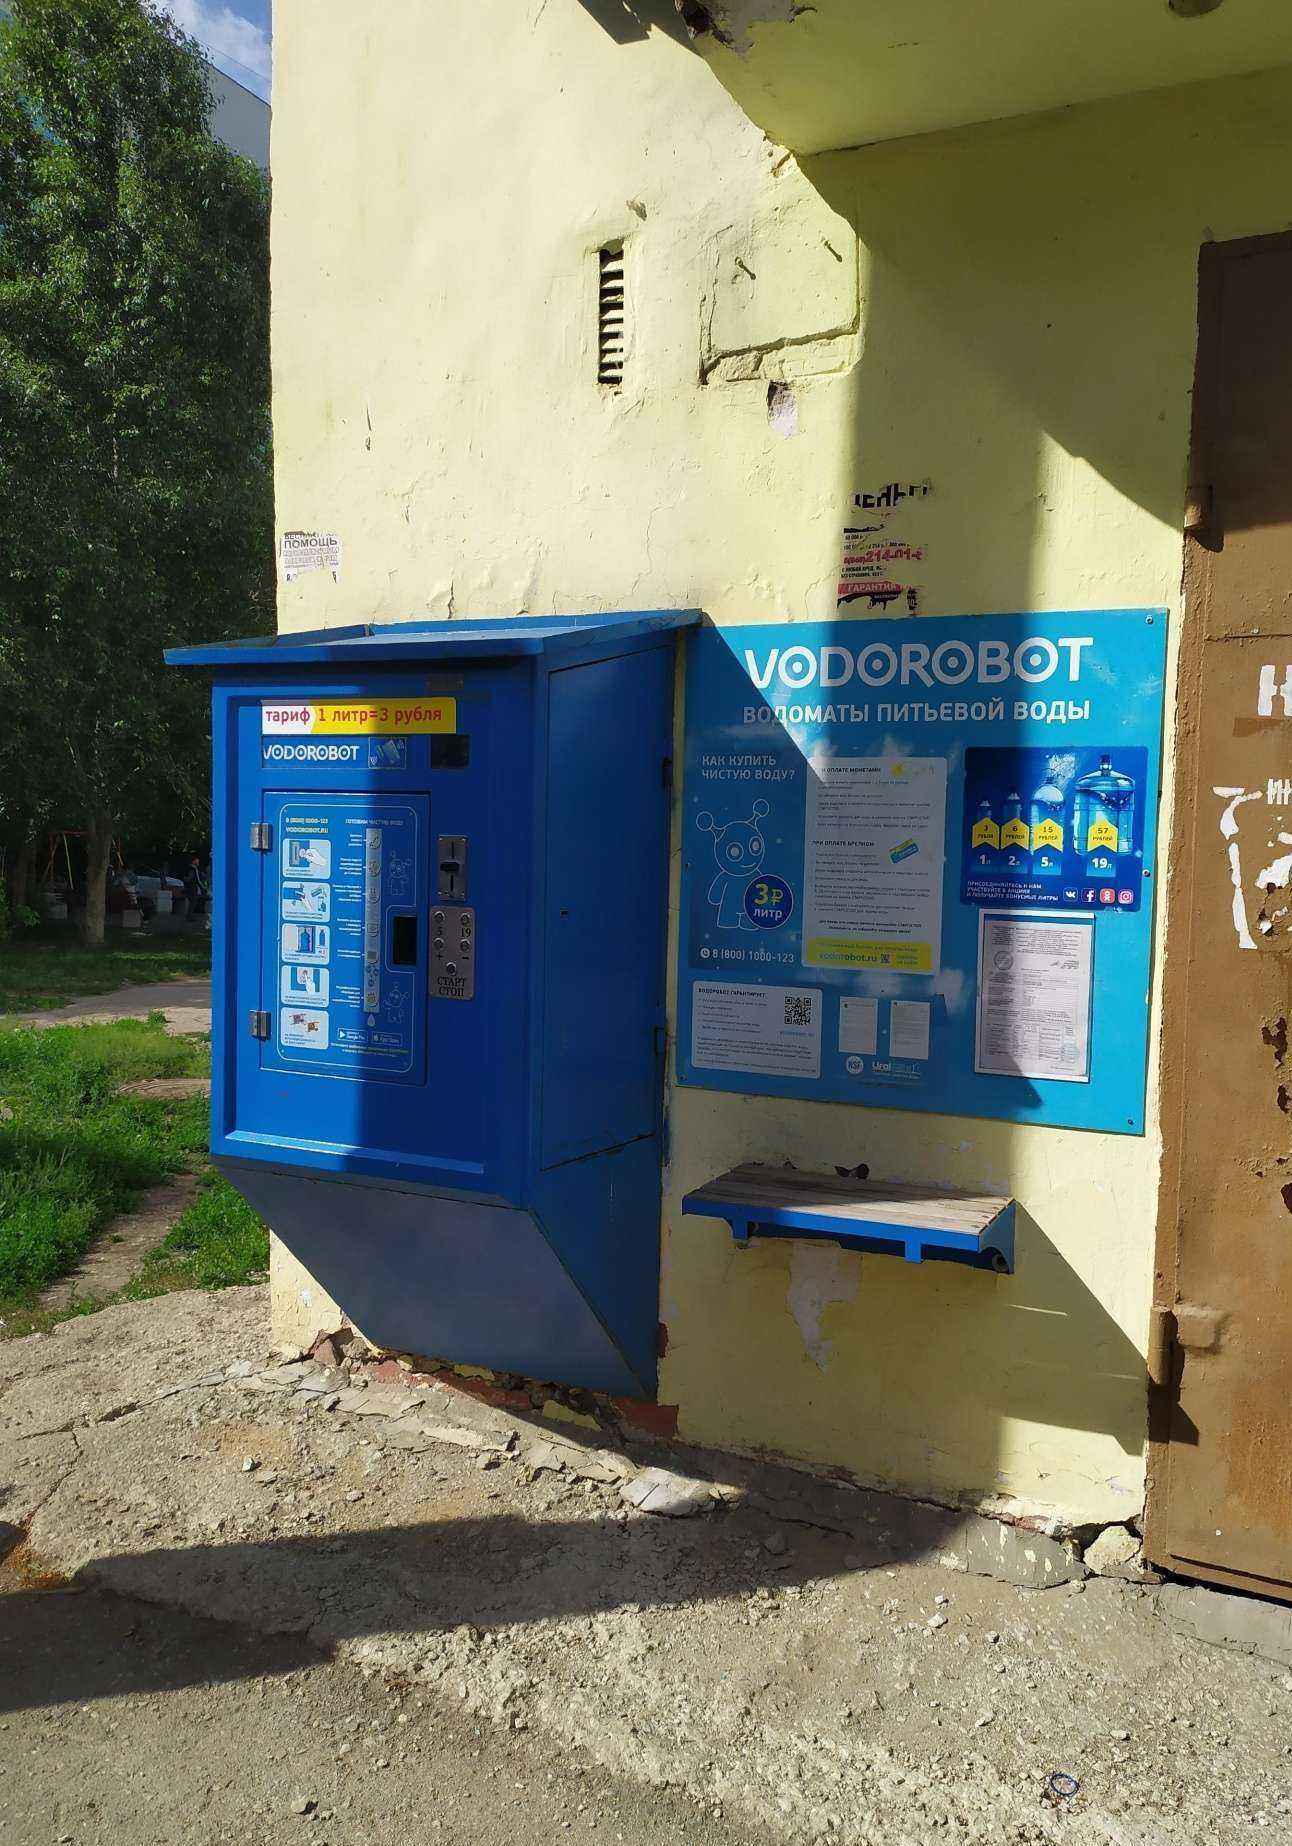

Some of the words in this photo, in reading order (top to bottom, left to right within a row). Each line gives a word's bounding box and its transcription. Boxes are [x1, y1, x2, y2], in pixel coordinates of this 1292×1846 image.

[285, 538, 337, 548] ПОМОЩЬ
[744, 637, 1094, 690] VODOROBOT
[266, 707, 310, 724] тариф
[319, 707, 325, 721] 1
[395, 707, 442, 724] рубля
[742, 705, 870, 725] ВОДОМАТЫ
[877, 698, 1005, 722] ПИТЬЕВОЙ
[1013, 700, 1090, 723] ВОДЫ
[263, 745, 359, 761] VODOROBOT
[702, 755, 725, 766] КАК
[729, 755, 776, 766] КУПИТЬ
[702, 769, 750, 780] ЧИСТУЮ
[755, 769, 795, 781] ВОДУ?
[754, 908, 783, 921] литр
[461, 927, 471, 938] 19
[712, 949, 718, 959] 8
[437, 977, 467, 987] СТАРТ
[439, 986, 464, 996] СТОП
